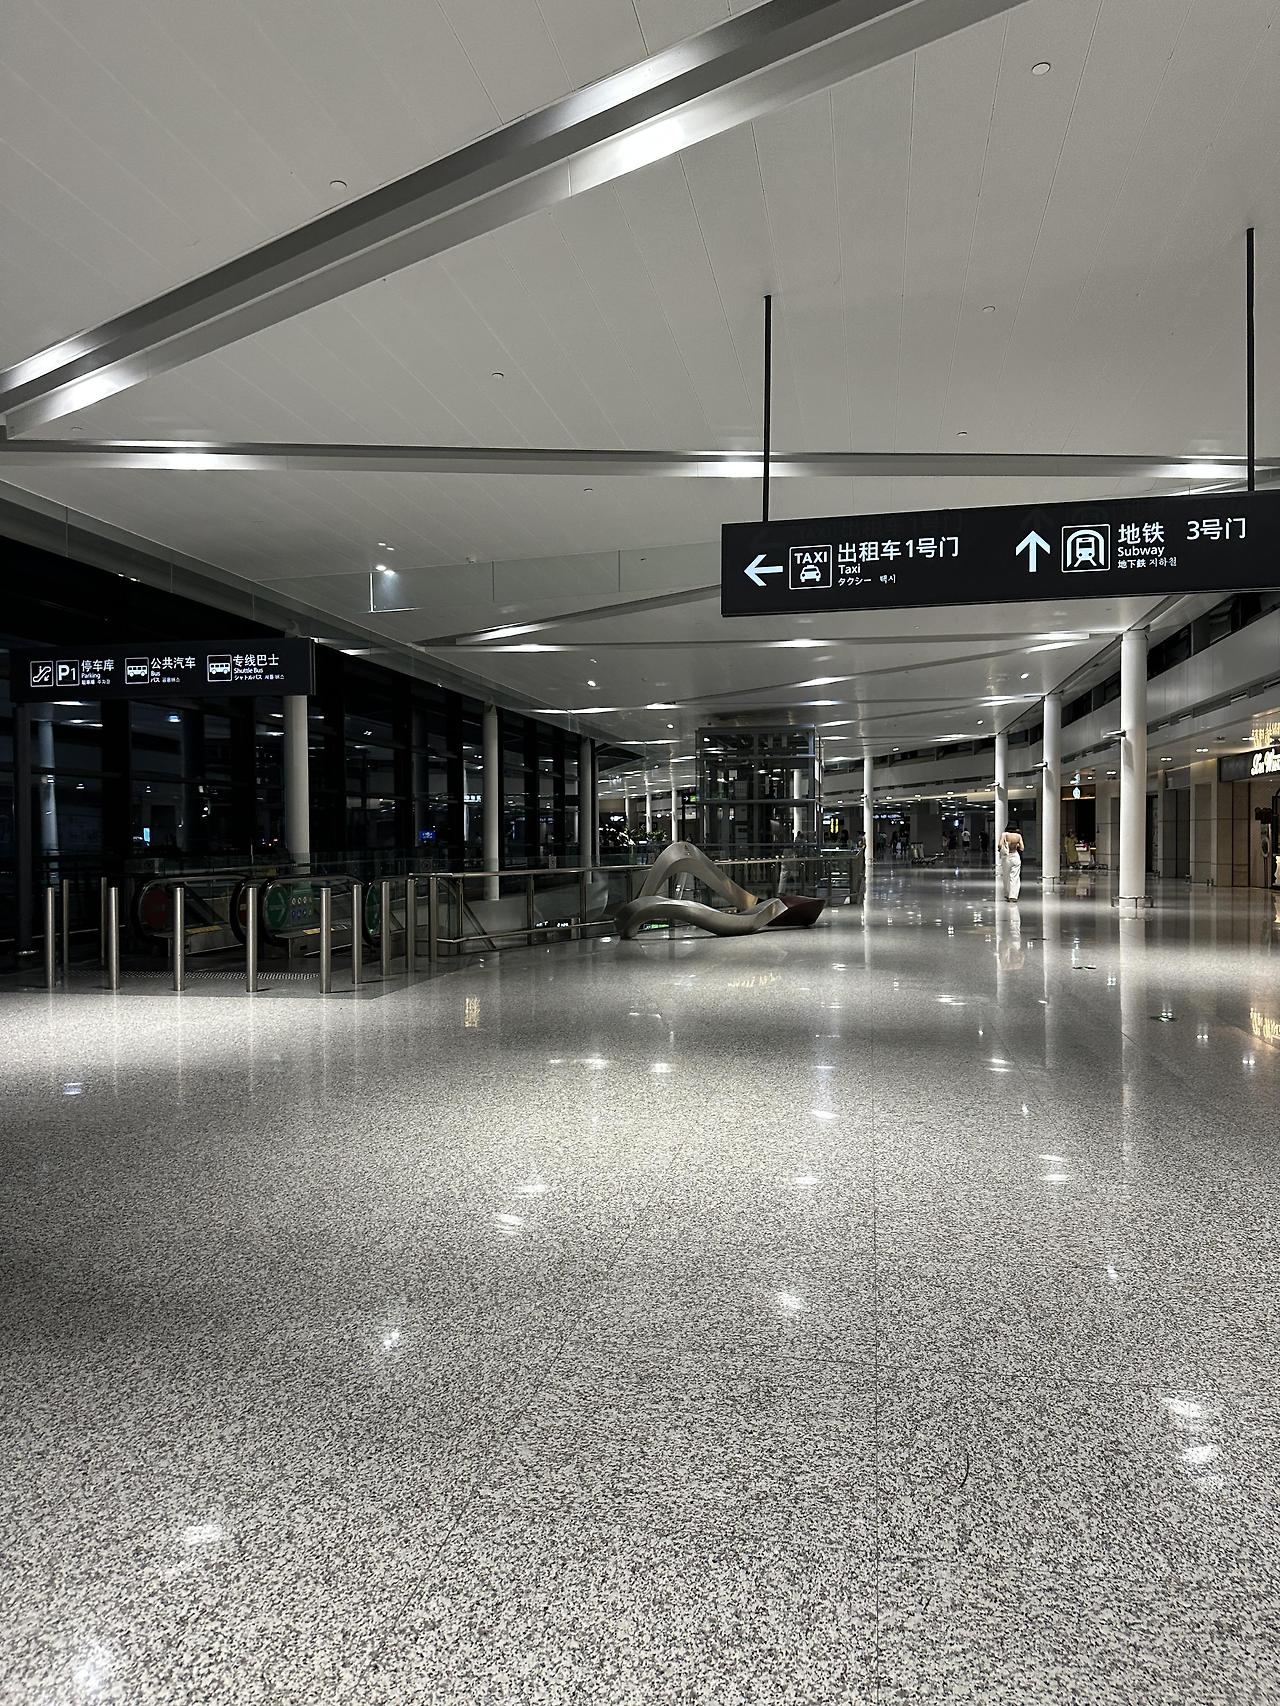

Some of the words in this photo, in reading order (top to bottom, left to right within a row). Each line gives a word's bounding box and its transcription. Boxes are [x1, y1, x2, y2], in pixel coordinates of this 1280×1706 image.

[1117, 522, 1165, 545] 地铁
[1186, 517, 1246, 540] 3号门
[794, 551, 828, 565] TAXI
[1117, 546, 1165, 557] Subway
[837, 563, 861, 575] Taxi
[837, 577, 872, 587] タクシー
[81, 659, 115, 673] 停车库
[150, 656, 196, 670] 公共汽车
[232, 653, 280, 667] 专线巴士
[57, 663, 77, 682] P1
[81, 672, 101, 680] Parking
[233, 667, 254, 675] Shuttle
[253, 666, 264, 674] Bus
